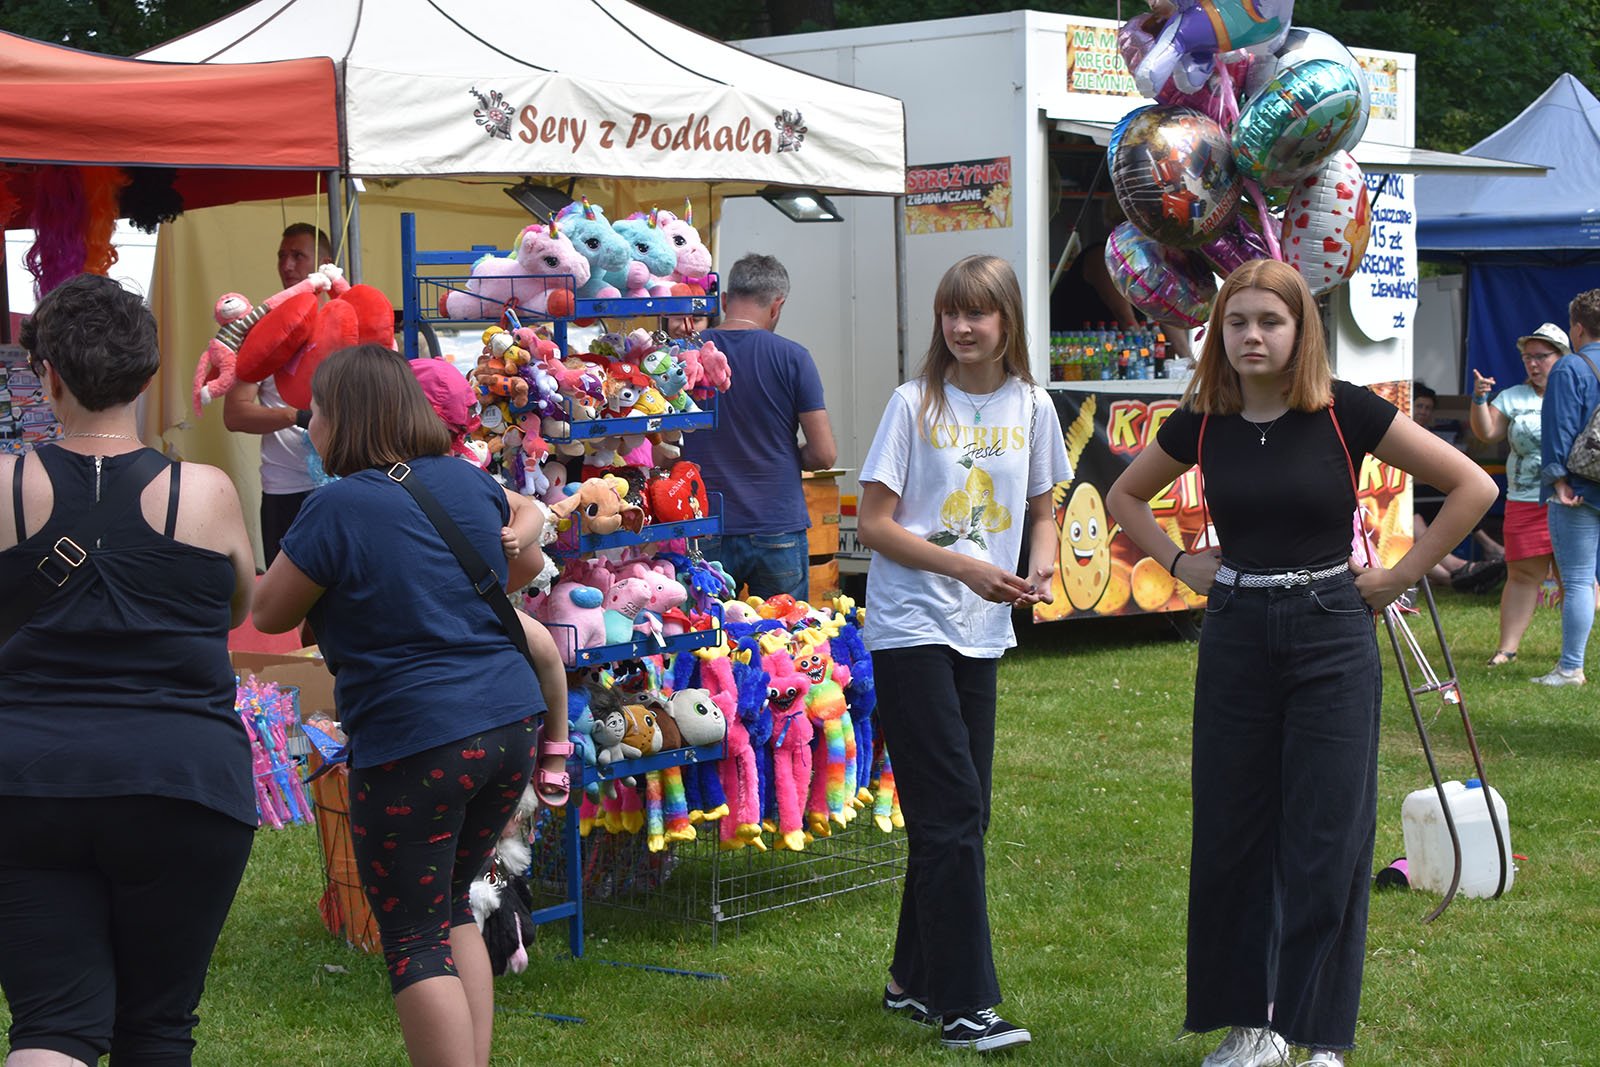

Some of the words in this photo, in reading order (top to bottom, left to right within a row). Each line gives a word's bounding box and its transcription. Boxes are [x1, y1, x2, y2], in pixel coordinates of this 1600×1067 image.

[1074, 31, 1095, 47] NA
[1076, 52, 1126, 72] KRĘCO
[1074, 73, 1138, 91] ZIEMNIA
[518, 104, 587, 154] Sery
[599, 120, 617, 149] z
[626, 112, 772, 155] Podhala
[907, 188, 982, 206] ZIEMNIACZANE
[1371, 224, 1386, 248] 15
[961, 439, 1006, 459] Fresh
